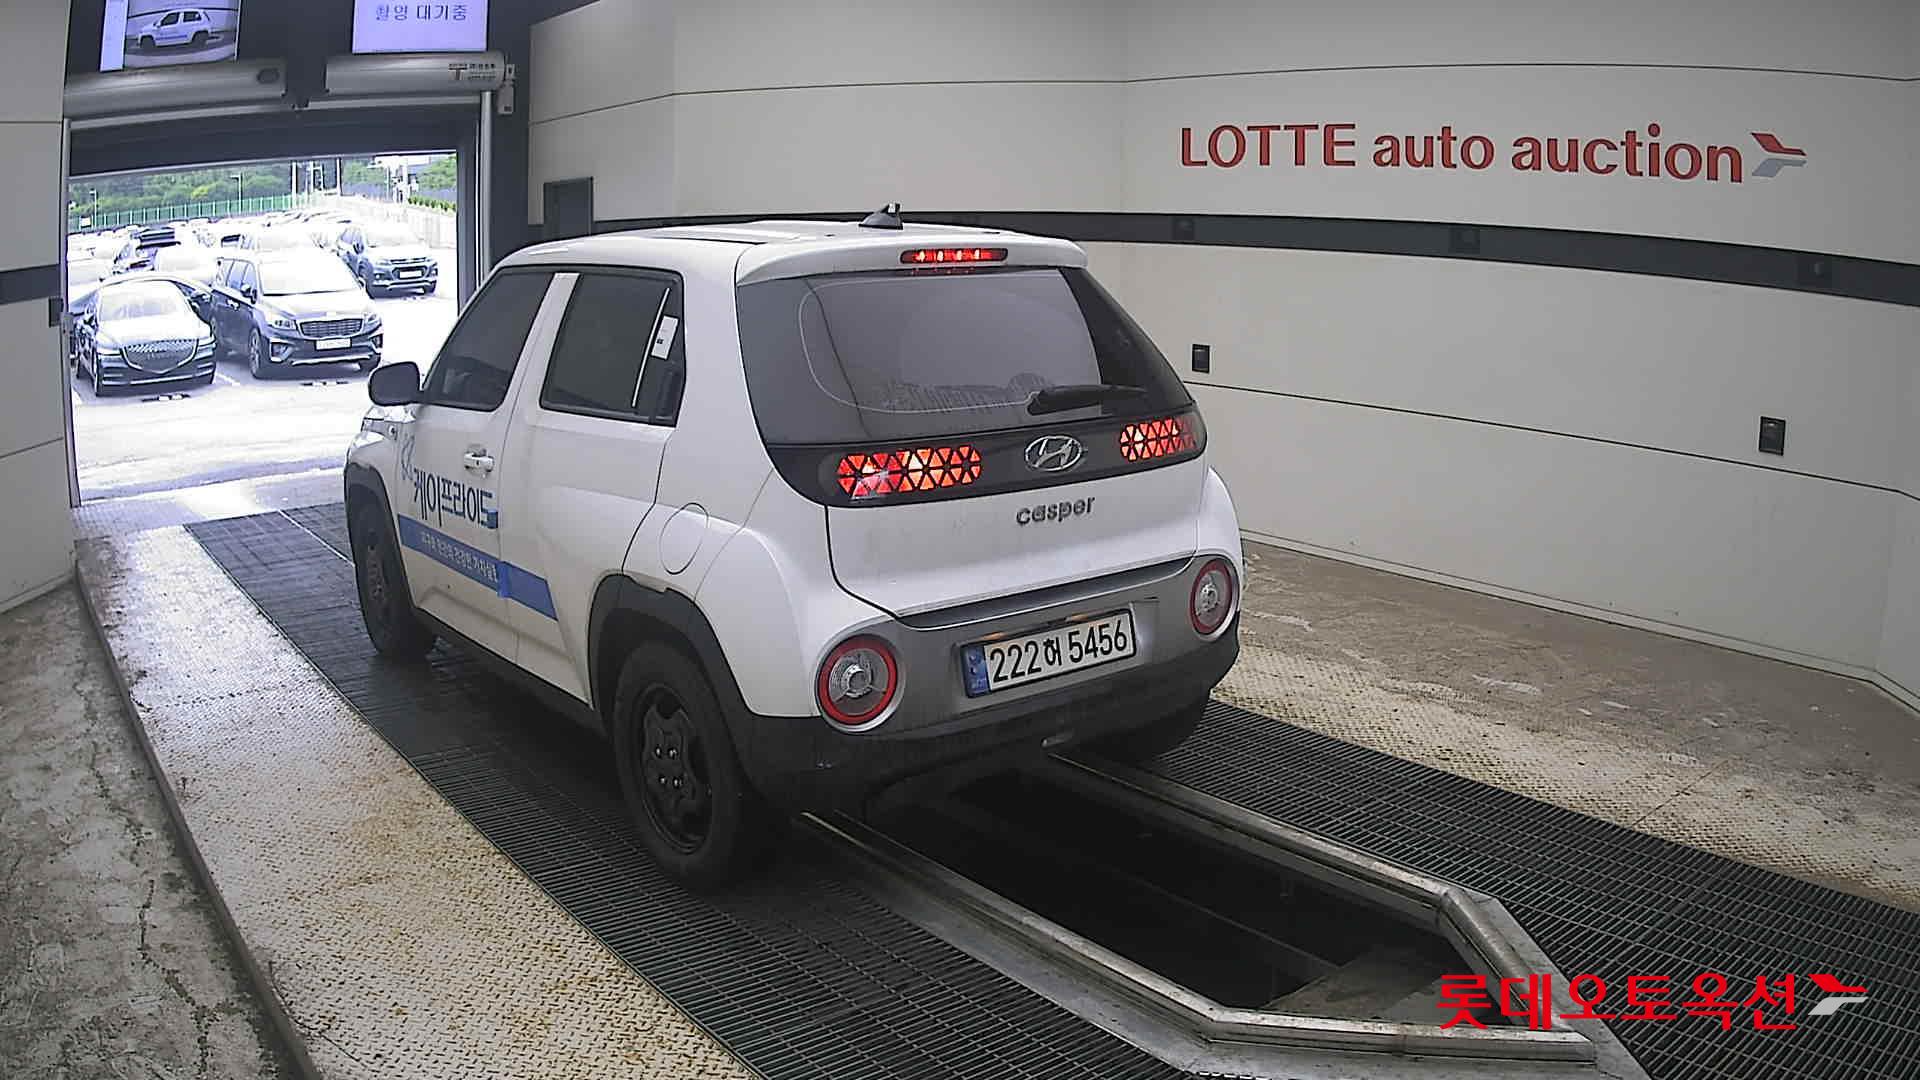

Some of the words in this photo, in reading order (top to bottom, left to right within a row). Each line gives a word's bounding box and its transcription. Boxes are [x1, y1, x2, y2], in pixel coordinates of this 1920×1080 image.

[417, 4, 466, 20] 대기중
[1182, 124, 1356, 167] LOTTE
[1373, 126, 1495, 169] auto
[1511, 123, 1743, 183] auction
[1016, 497, 1095, 525] casper
[989, 636, 1063, 683] 222허
[1067, 619, 1128, 664] 5456
